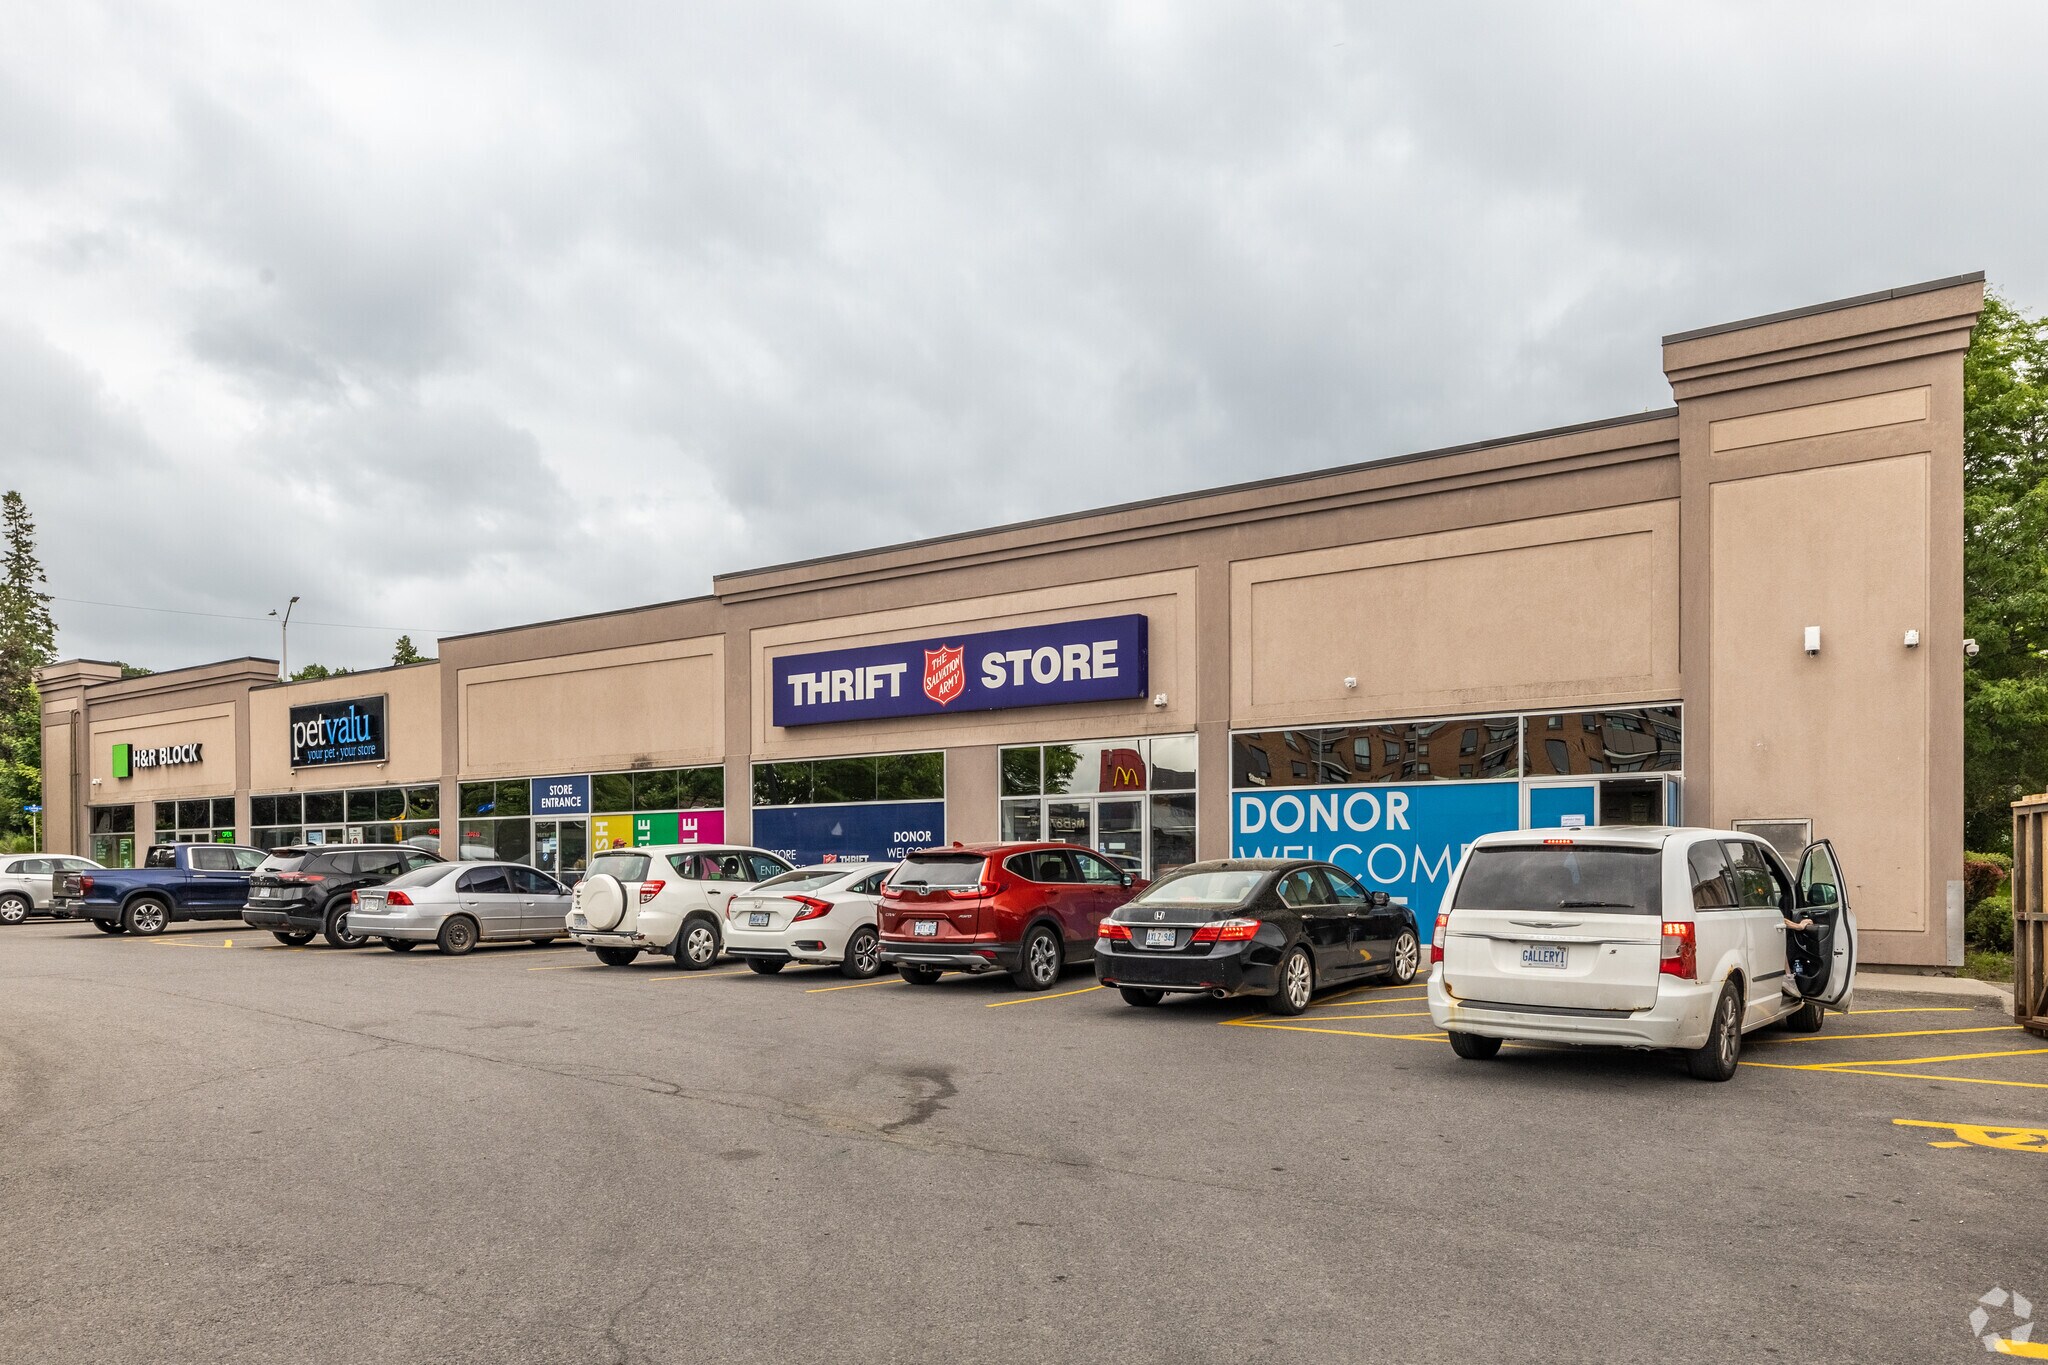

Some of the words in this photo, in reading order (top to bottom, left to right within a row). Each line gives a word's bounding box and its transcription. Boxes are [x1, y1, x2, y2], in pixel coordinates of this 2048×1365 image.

[926, 654, 960, 690] SALVATION
[932, 652, 947, 670] THE
[787, 662, 907, 706] THRIFT
[981, 639, 1119, 689] STORE
[938, 670, 960, 697] ARMY
[133, 749, 157, 768] H&R
[160, 743, 199, 765] BLOCK
[307, 749, 323, 763] your
[324, 747, 335, 761] pet
[340, 745, 356, 760] your
[358, 744, 376, 756] store
[549, 784, 573, 796] STORE
[541, 796, 582, 808] ENTRANCE
[1239, 791, 1411, 834] DONOR
[893, 830, 932, 843] DONOR
